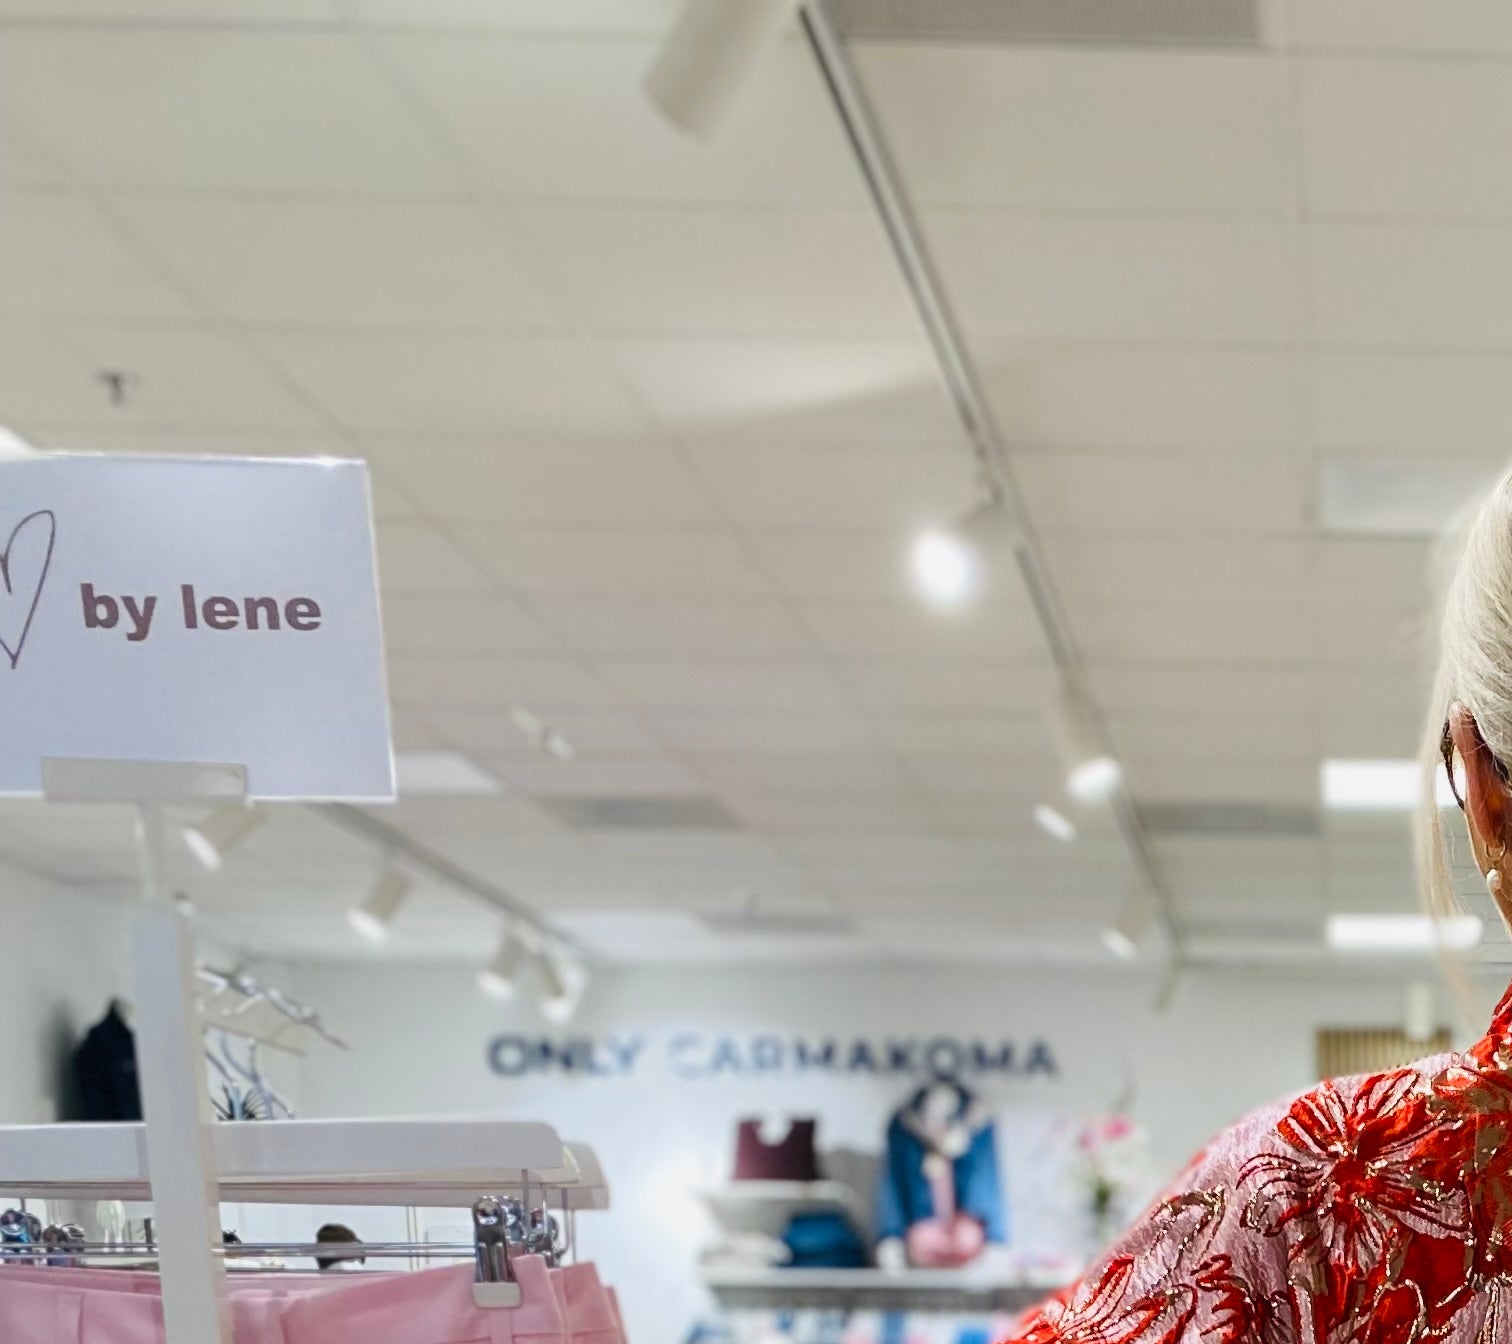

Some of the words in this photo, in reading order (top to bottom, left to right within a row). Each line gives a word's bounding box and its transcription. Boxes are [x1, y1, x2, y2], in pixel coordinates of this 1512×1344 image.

[80, 583, 157, 642] by
[181, 584, 322, 631] lene
[488, 1034, 645, 1077] ONLY
[667, 1034, 1060, 1078] CARMAKOMA
